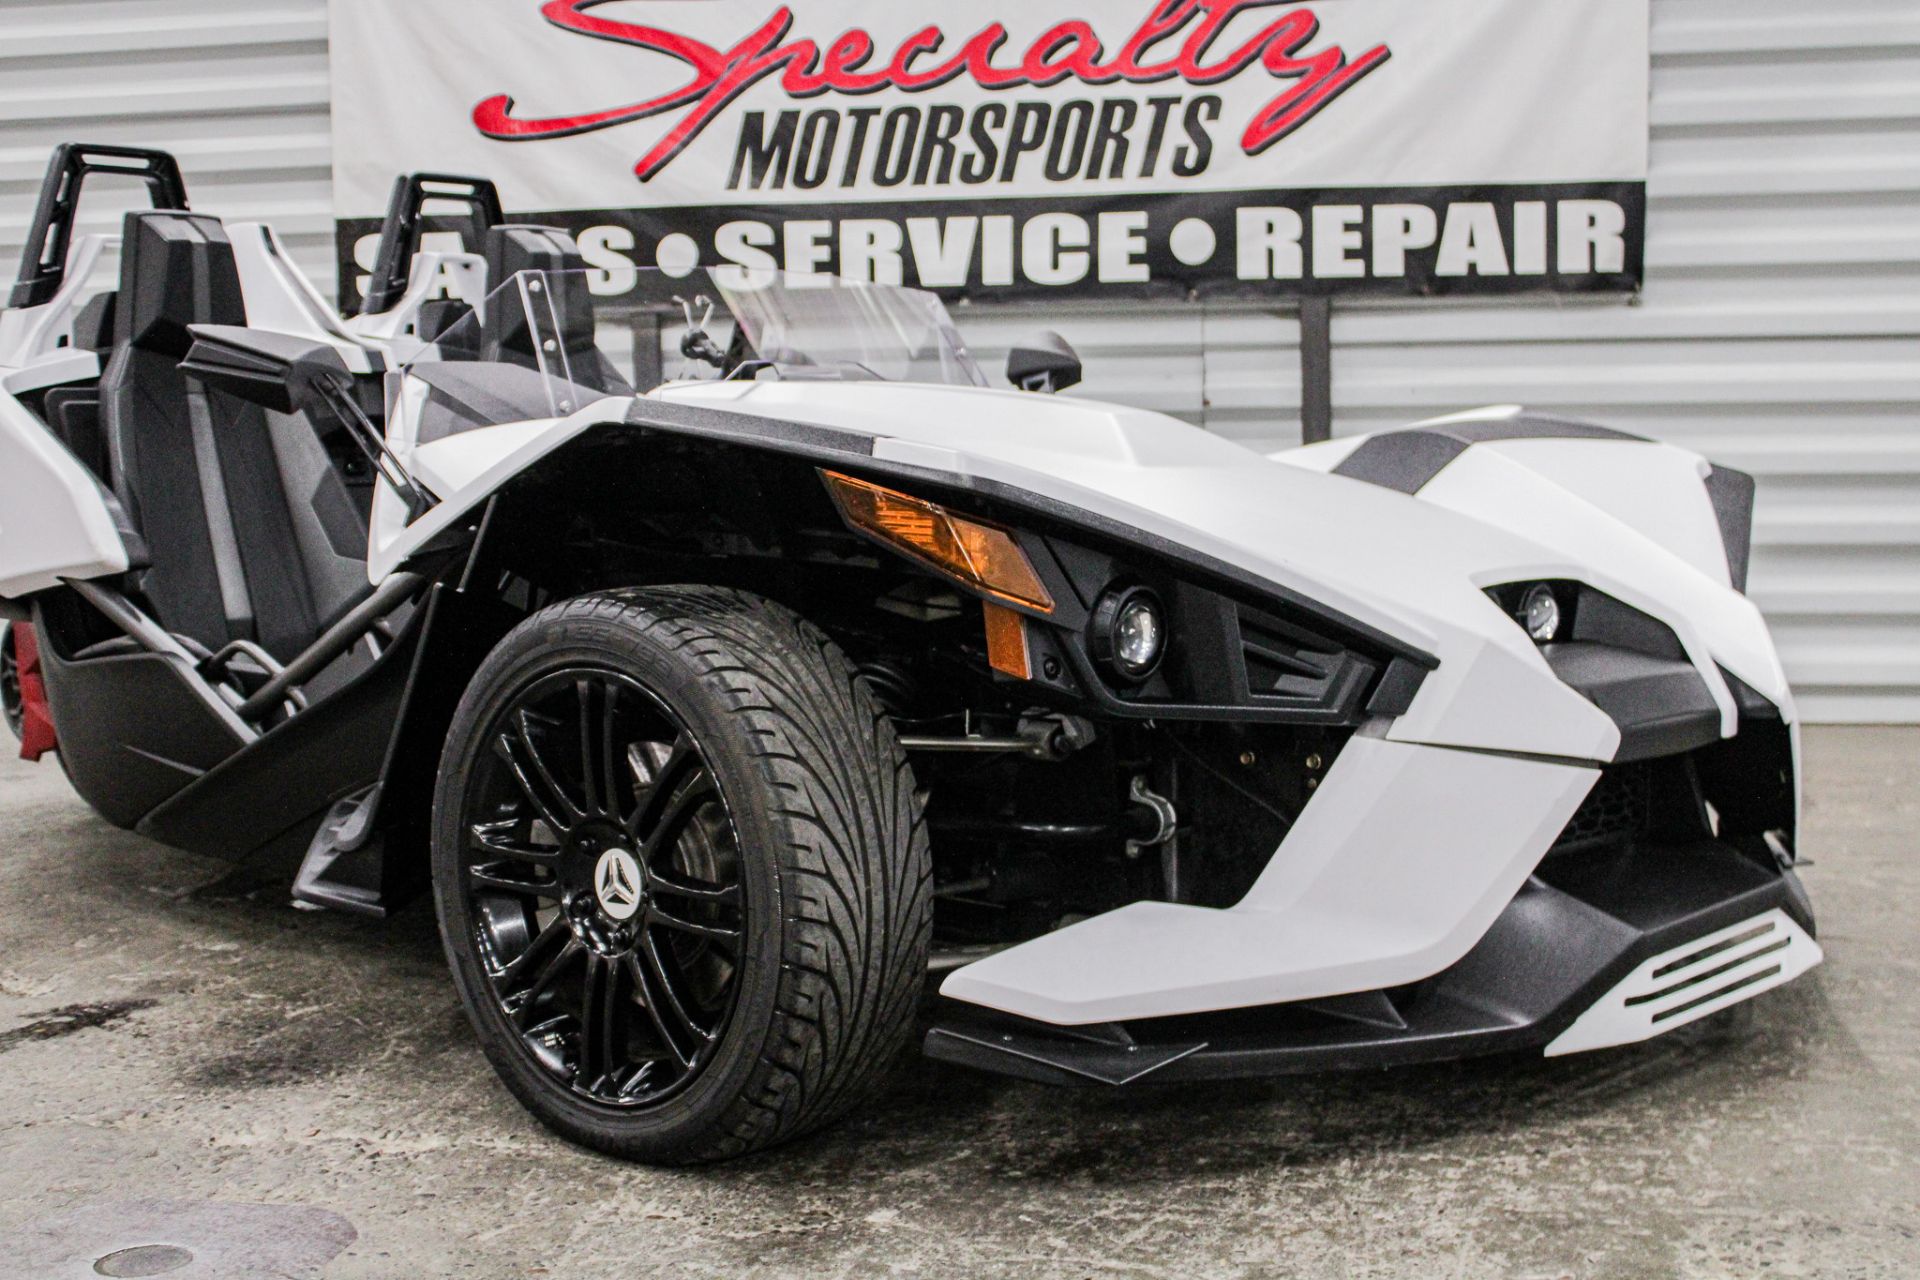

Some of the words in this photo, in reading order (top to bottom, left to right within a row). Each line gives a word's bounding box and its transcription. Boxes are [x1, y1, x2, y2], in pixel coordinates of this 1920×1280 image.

[471, 0, 1391, 181] Specialty
[726, 96, 1222, 190] MOTORSPORTS
[714, 211, 1151, 291] SERVICE
[1235, 200, 1626, 280] REPAIR
